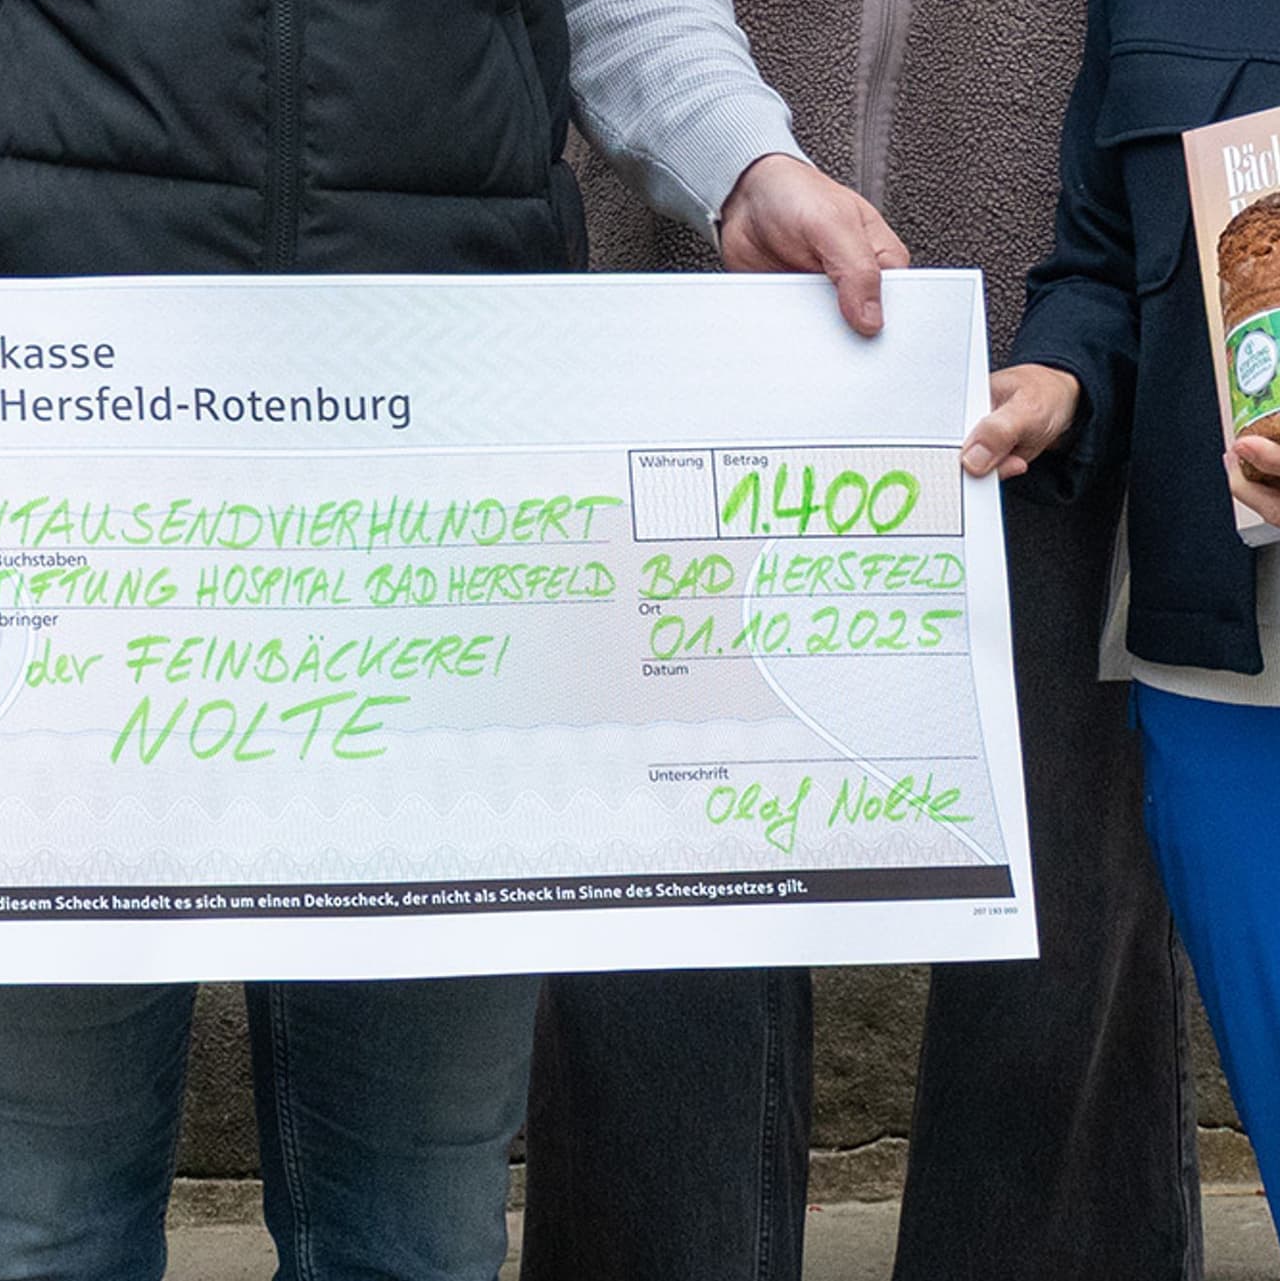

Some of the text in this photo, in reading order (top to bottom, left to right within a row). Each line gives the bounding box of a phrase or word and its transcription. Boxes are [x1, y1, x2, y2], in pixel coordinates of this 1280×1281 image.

[0, 385, 411, 429] Hersfeld-Rotenburg
[638, 455, 704, 470] Währung
[723, 454, 769, 469] Betrag
[721, 463, 921, 536] 1.400
[197, 564, 351, 606] HOSPITAL
[365, 563, 438, 604] BAD
[448, 561, 616, 600] HERSFELD
[638, 551, 965, 600] BAD HERSFELD
[638, 602, 662, 616] Ort
[650, 606, 963, 660] 01.10.2025
[25, 638, 104, 688] der
[126, 634, 510, 684] FEINBÄCKEREI
[642, 663, 689, 677] Datum
[110, 691, 411, 764] NOLTE
[648, 766, 730, 783] Unterschrift
[705, 773, 974, 854] Olaf Nolte
[55, 894, 109, 911] Scheck
[112, 894, 171, 910] handelt
[174, 897, 192, 910] es
[195, 893, 227, 910] sich
[230, 896, 254, 909] um
[257, 893, 301, 909] einen
[304, 892, 400, 910] Dekoscheck,
[403, 891, 428, 906] der
[432, 890, 471, 905] nicht
[474, 889, 497, 903] als
[499, 887, 553, 903] Scheck
[556, 886, 576, 901] im
[579, 885, 622, 900] Sinne
[626, 884, 653, 899] des
[656, 880, 775, 900] Scheckgesetzes
[778, 878, 809, 896] gilt.
